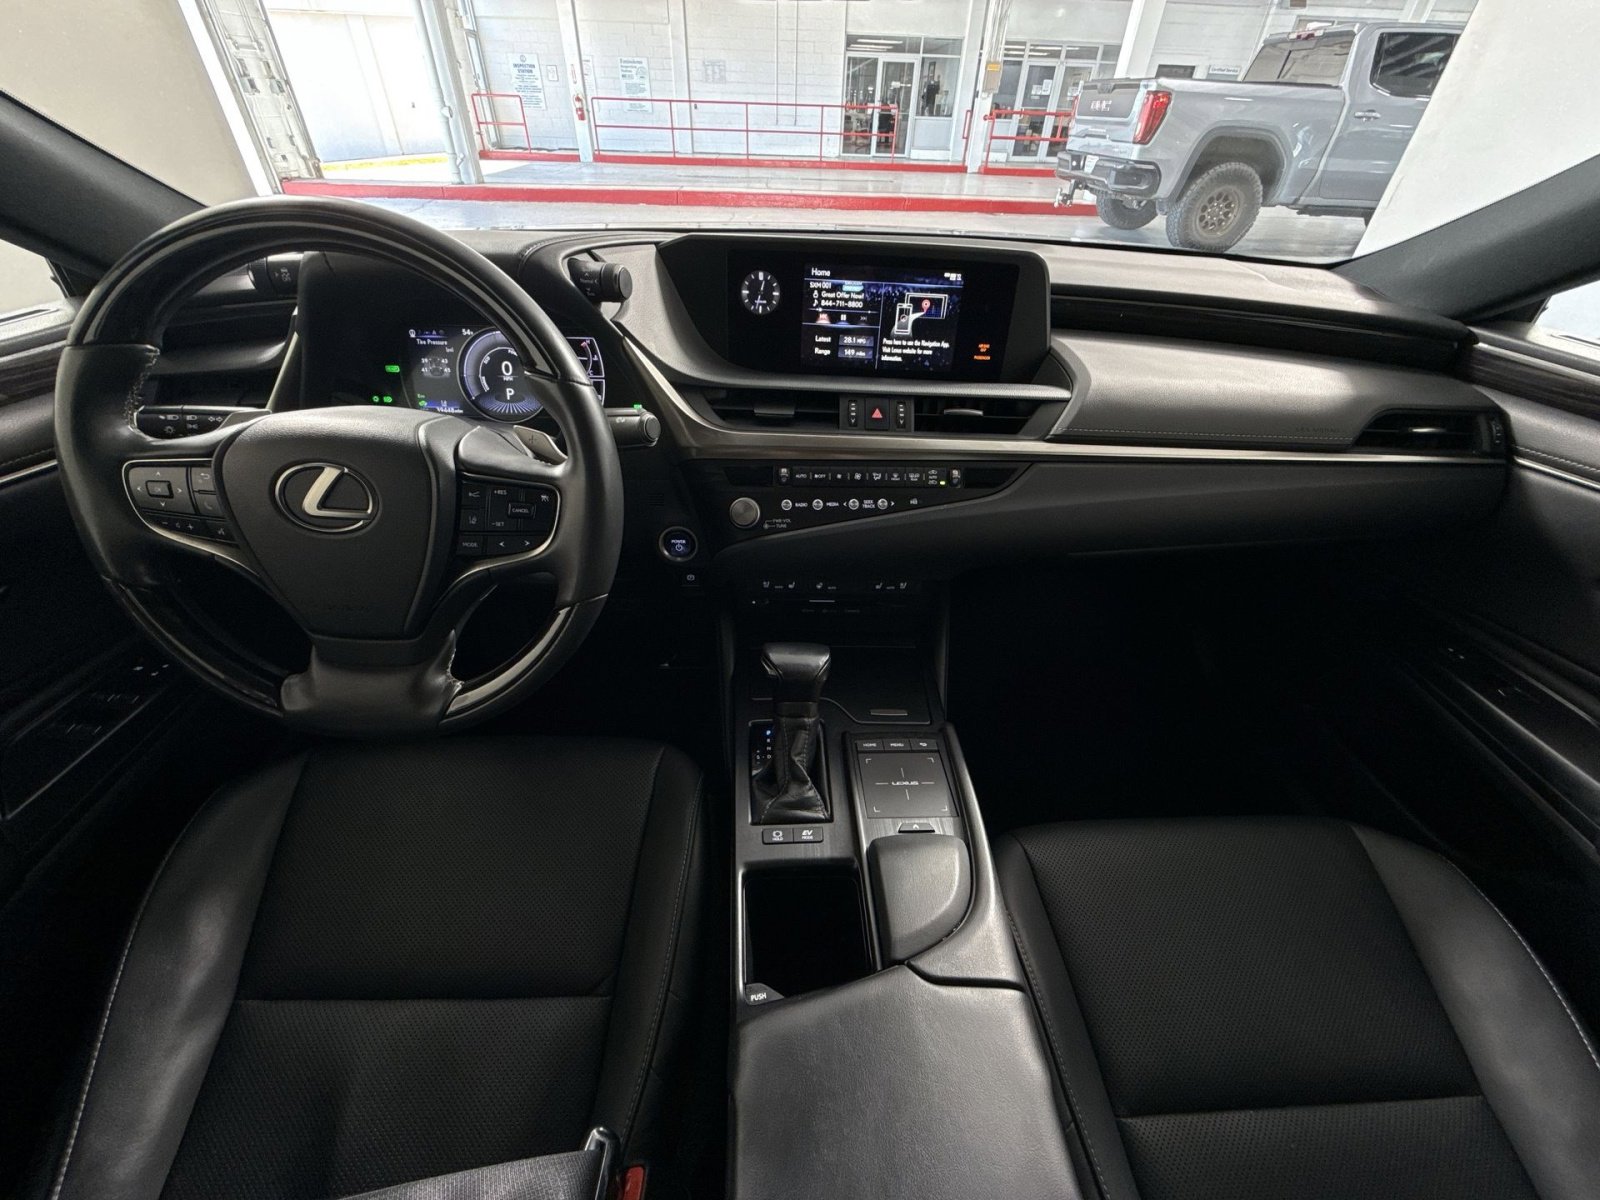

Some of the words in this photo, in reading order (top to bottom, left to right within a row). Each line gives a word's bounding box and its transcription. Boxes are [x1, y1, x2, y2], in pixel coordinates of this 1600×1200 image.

[812, 267, 830, 276] Home
[814, 348, 830, 356] Range
[502, 361, 512, 375] 0
[506, 388, 515, 400] P
[750, 992, 767, 1001] PUSH
